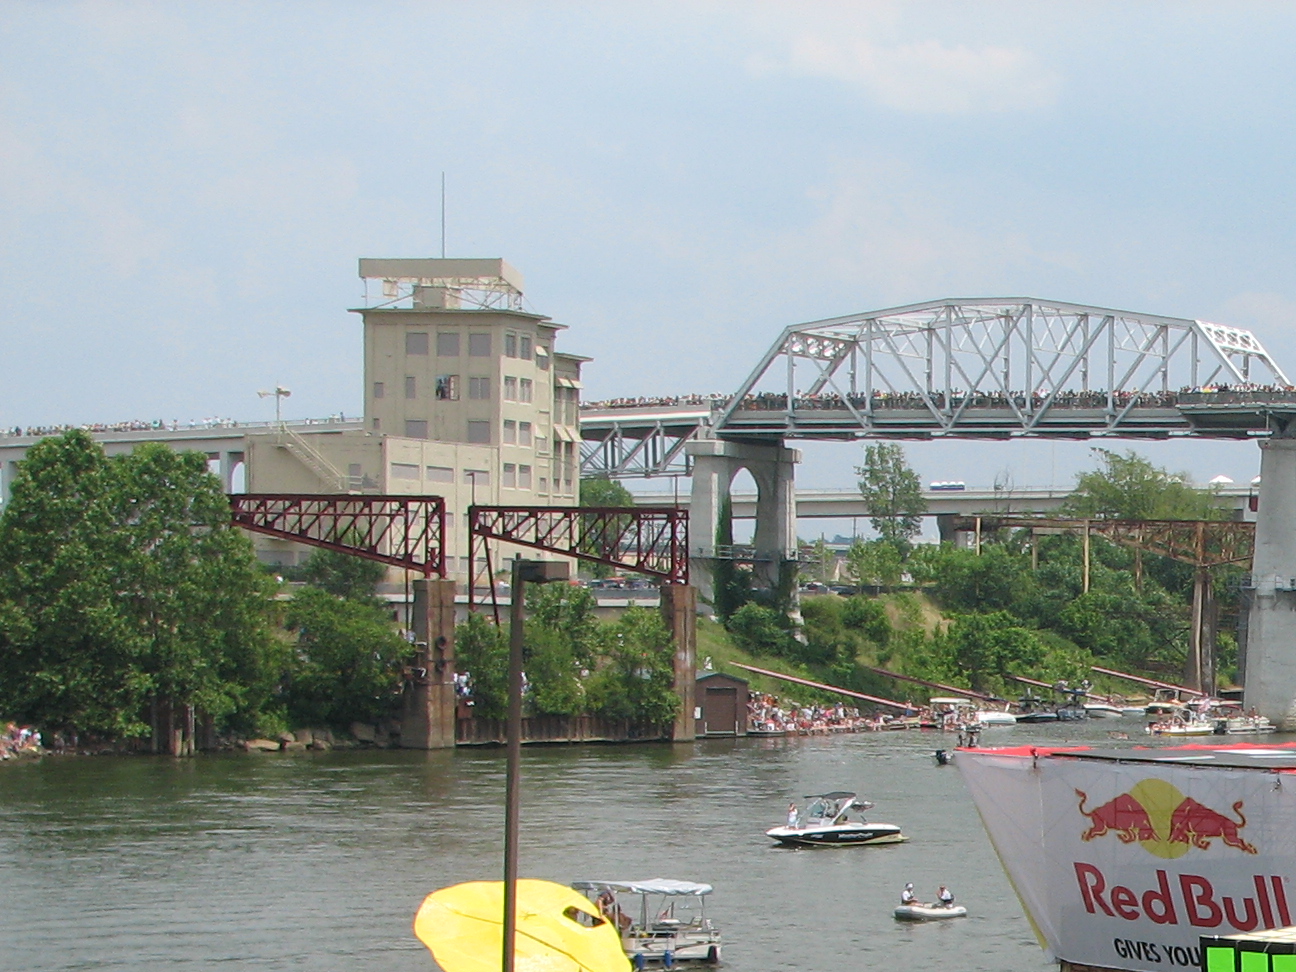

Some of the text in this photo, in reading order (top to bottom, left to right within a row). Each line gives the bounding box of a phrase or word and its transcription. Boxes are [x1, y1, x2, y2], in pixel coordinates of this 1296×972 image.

[1073, 861, 1292, 931] Red Bull
[1113, 938, 1201, 967] GIVES YOU
